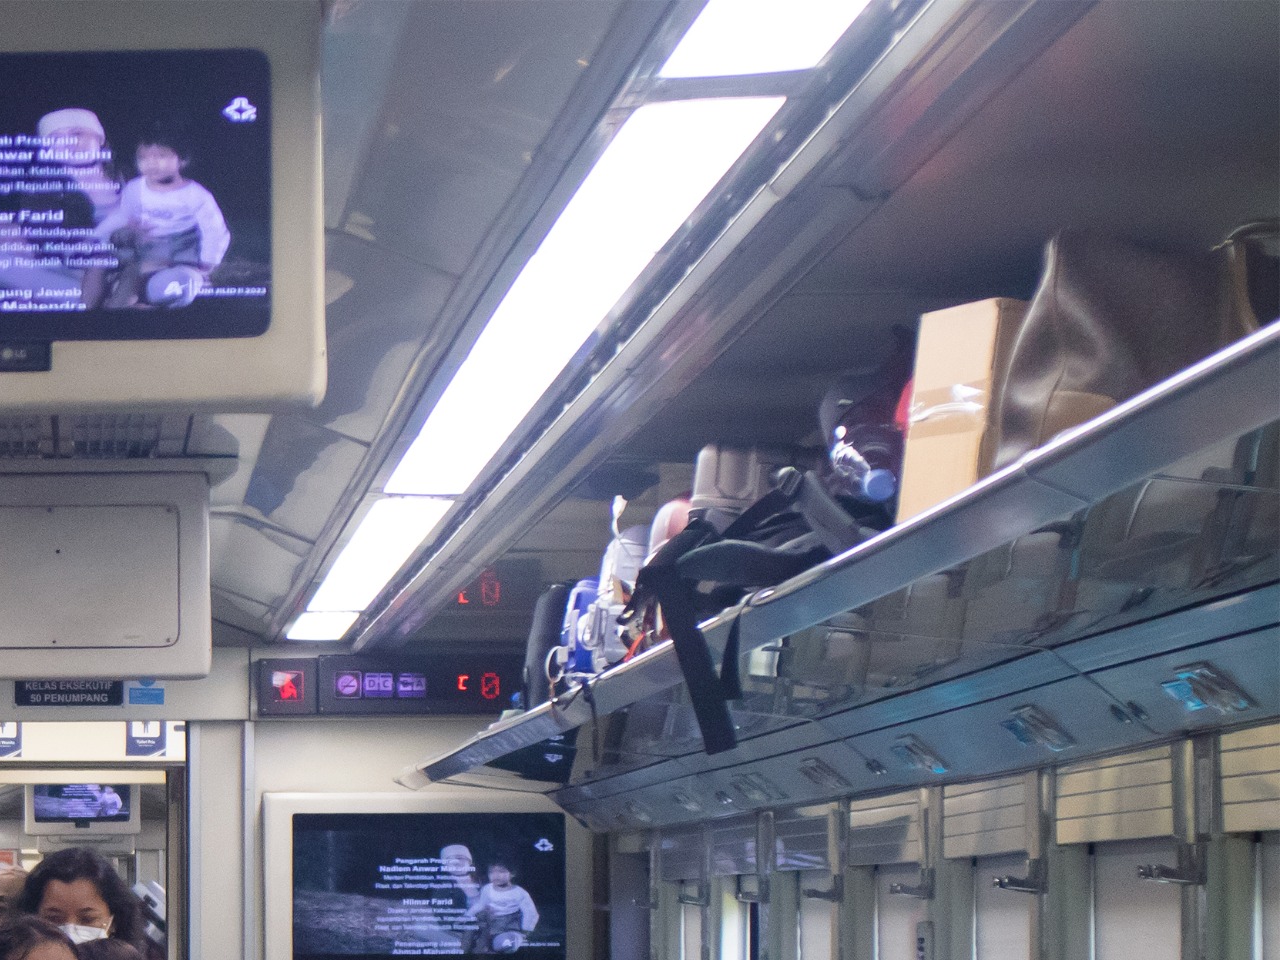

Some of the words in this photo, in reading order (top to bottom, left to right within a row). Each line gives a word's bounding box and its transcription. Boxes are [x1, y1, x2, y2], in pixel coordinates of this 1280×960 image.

[18, 209, 64, 223] Farid
[36, 287, 82, 298] Jawab
[25, 681, 57, 691] KELAS
[59, 681, 113, 691] EKSEKUTIF
[30, 693, 41, 703] 50
[44, 693, 109, 703] PENUMPANG
